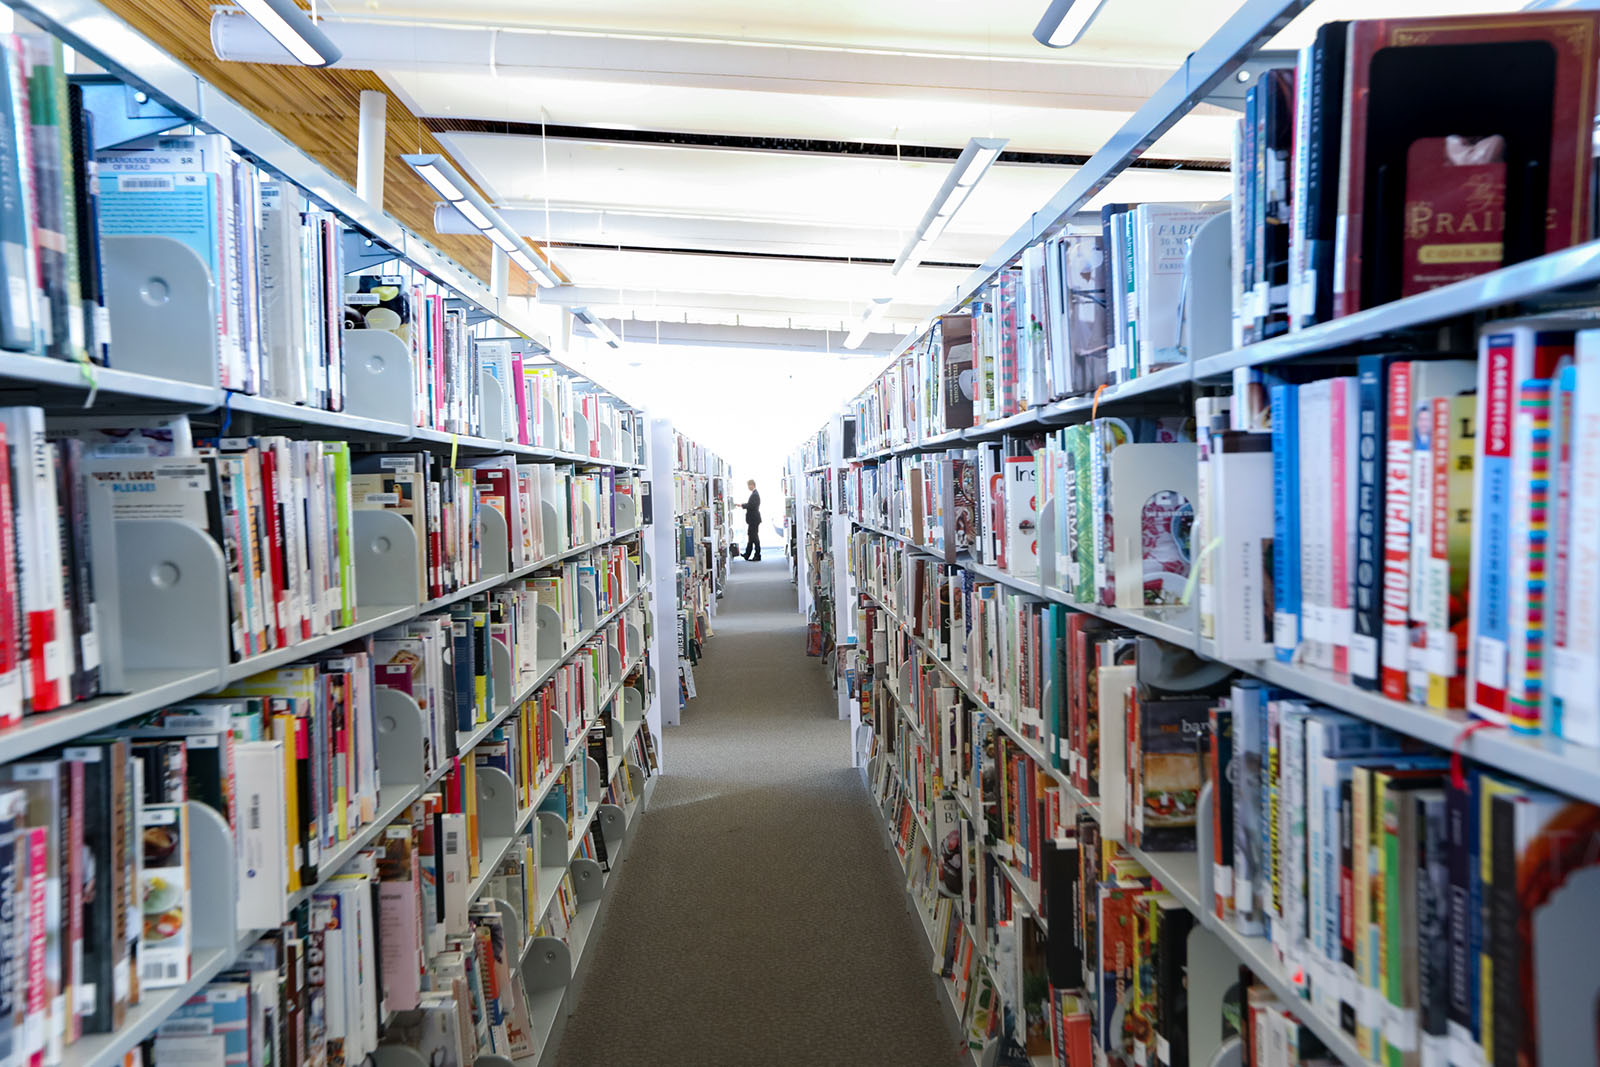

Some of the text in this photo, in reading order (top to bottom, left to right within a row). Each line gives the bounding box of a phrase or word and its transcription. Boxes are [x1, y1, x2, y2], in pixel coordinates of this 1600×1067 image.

[1406, 202, 1557, 238] PRAIE
[1491, 354, 1509, 452] AMERICA
[32, 431, 47, 481] KNIFE
[1066, 469, 1078, 551] BURMA
[1384, 439, 1411, 627] MEXICAN TODA
